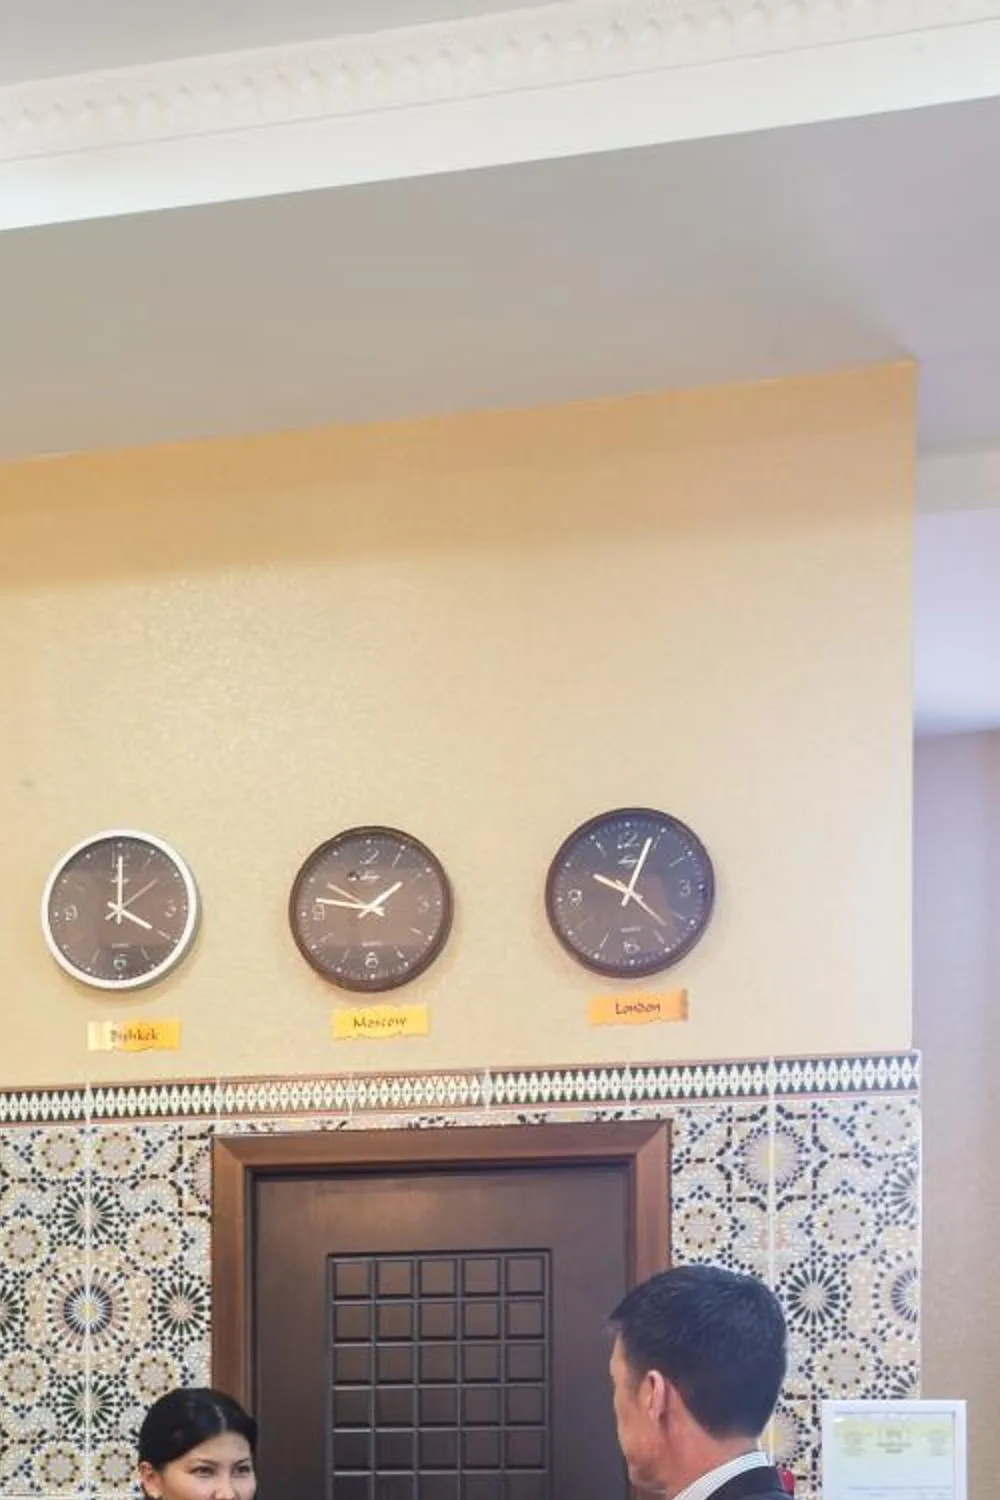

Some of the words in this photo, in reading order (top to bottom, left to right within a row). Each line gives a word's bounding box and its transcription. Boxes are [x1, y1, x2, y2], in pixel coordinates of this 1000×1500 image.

[679, 879, 692, 897] 3
[364, 951, 379, 969] 6
[353, 1015, 407, 1029] Moscow
